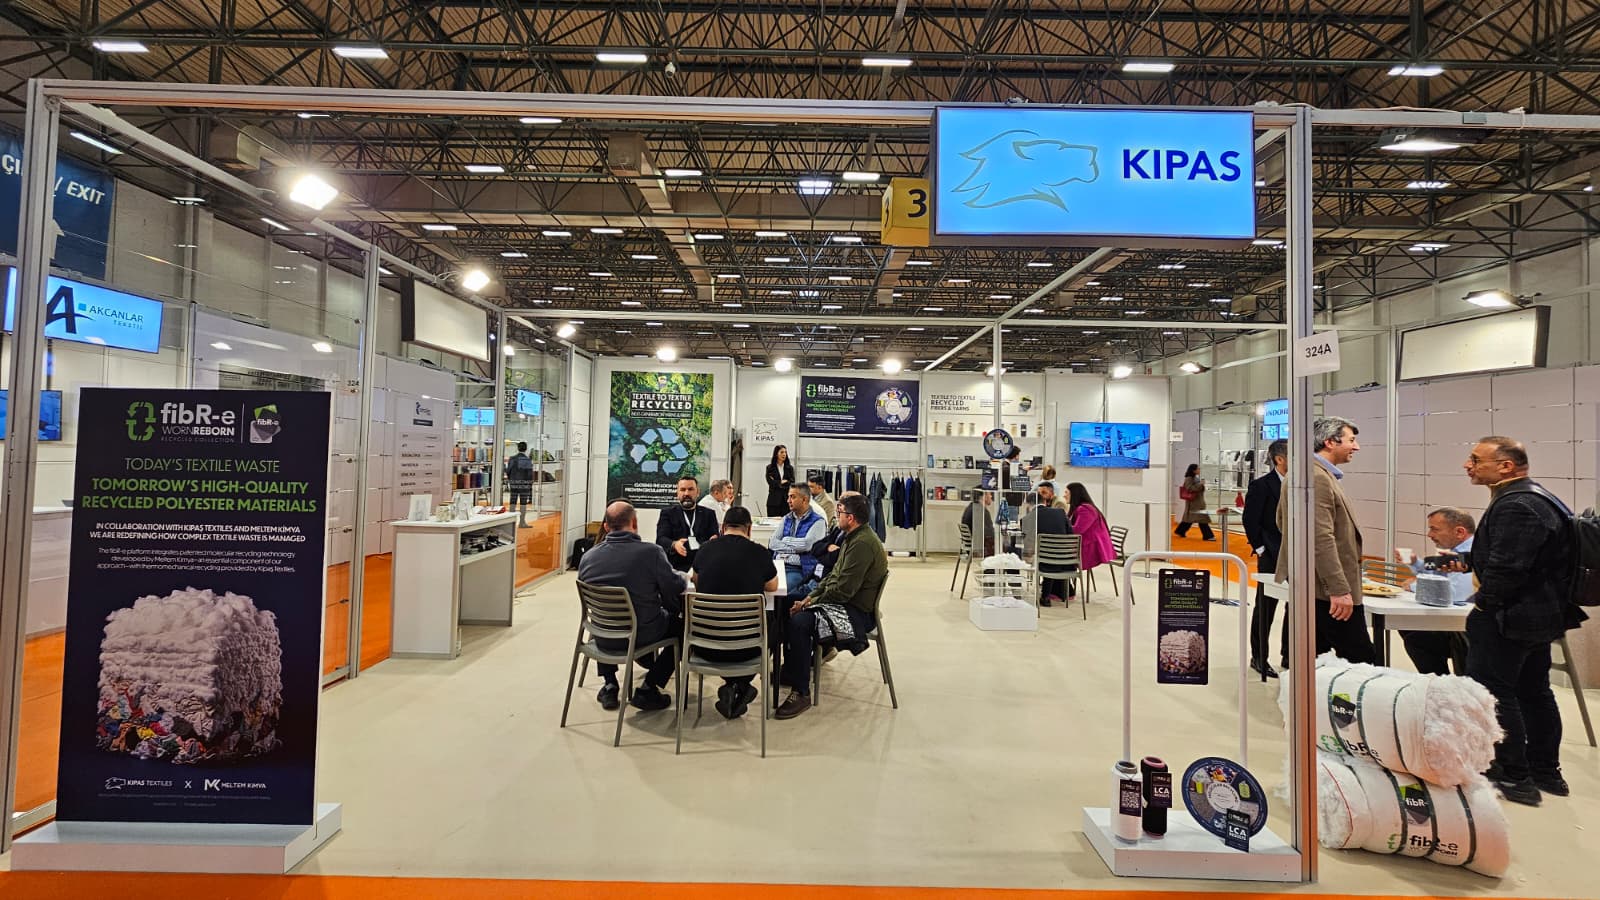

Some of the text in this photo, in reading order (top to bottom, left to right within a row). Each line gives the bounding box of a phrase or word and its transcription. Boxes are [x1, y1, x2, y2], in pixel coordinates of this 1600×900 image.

[1123, 149, 1241, 182] KIPAS
[66, 180, 105, 205] EXIT
[907, 188, 927, 218] 3
[89, 305, 144, 323] AKCANLAR
[1305, 343, 1332, 358] 324A
[631, 400, 692, 409] RECYCLED
[160, 402, 236, 425] fibR-e
[186, 459, 232, 472] TEXTILE
[234, 460, 280, 473] WASTE
[201, 480, 309, 494] HIGH-QUALITY
[82, 495, 317, 513] RECYCLED POLYESTER MATERIALS
[104, 523, 165, 531] COLLABORATION
[250, 525, 278, 533] MELTEM
[102, 531, 115, 539] ARE
[158, 532, 177, 540] HOW
[177, 533, 211, 541] COMPLEX
[238, 534, 261, 542] WASTE
[1405, 798, 1429, 807] fibR-
[1228, 825, 1247, 836] LCA
